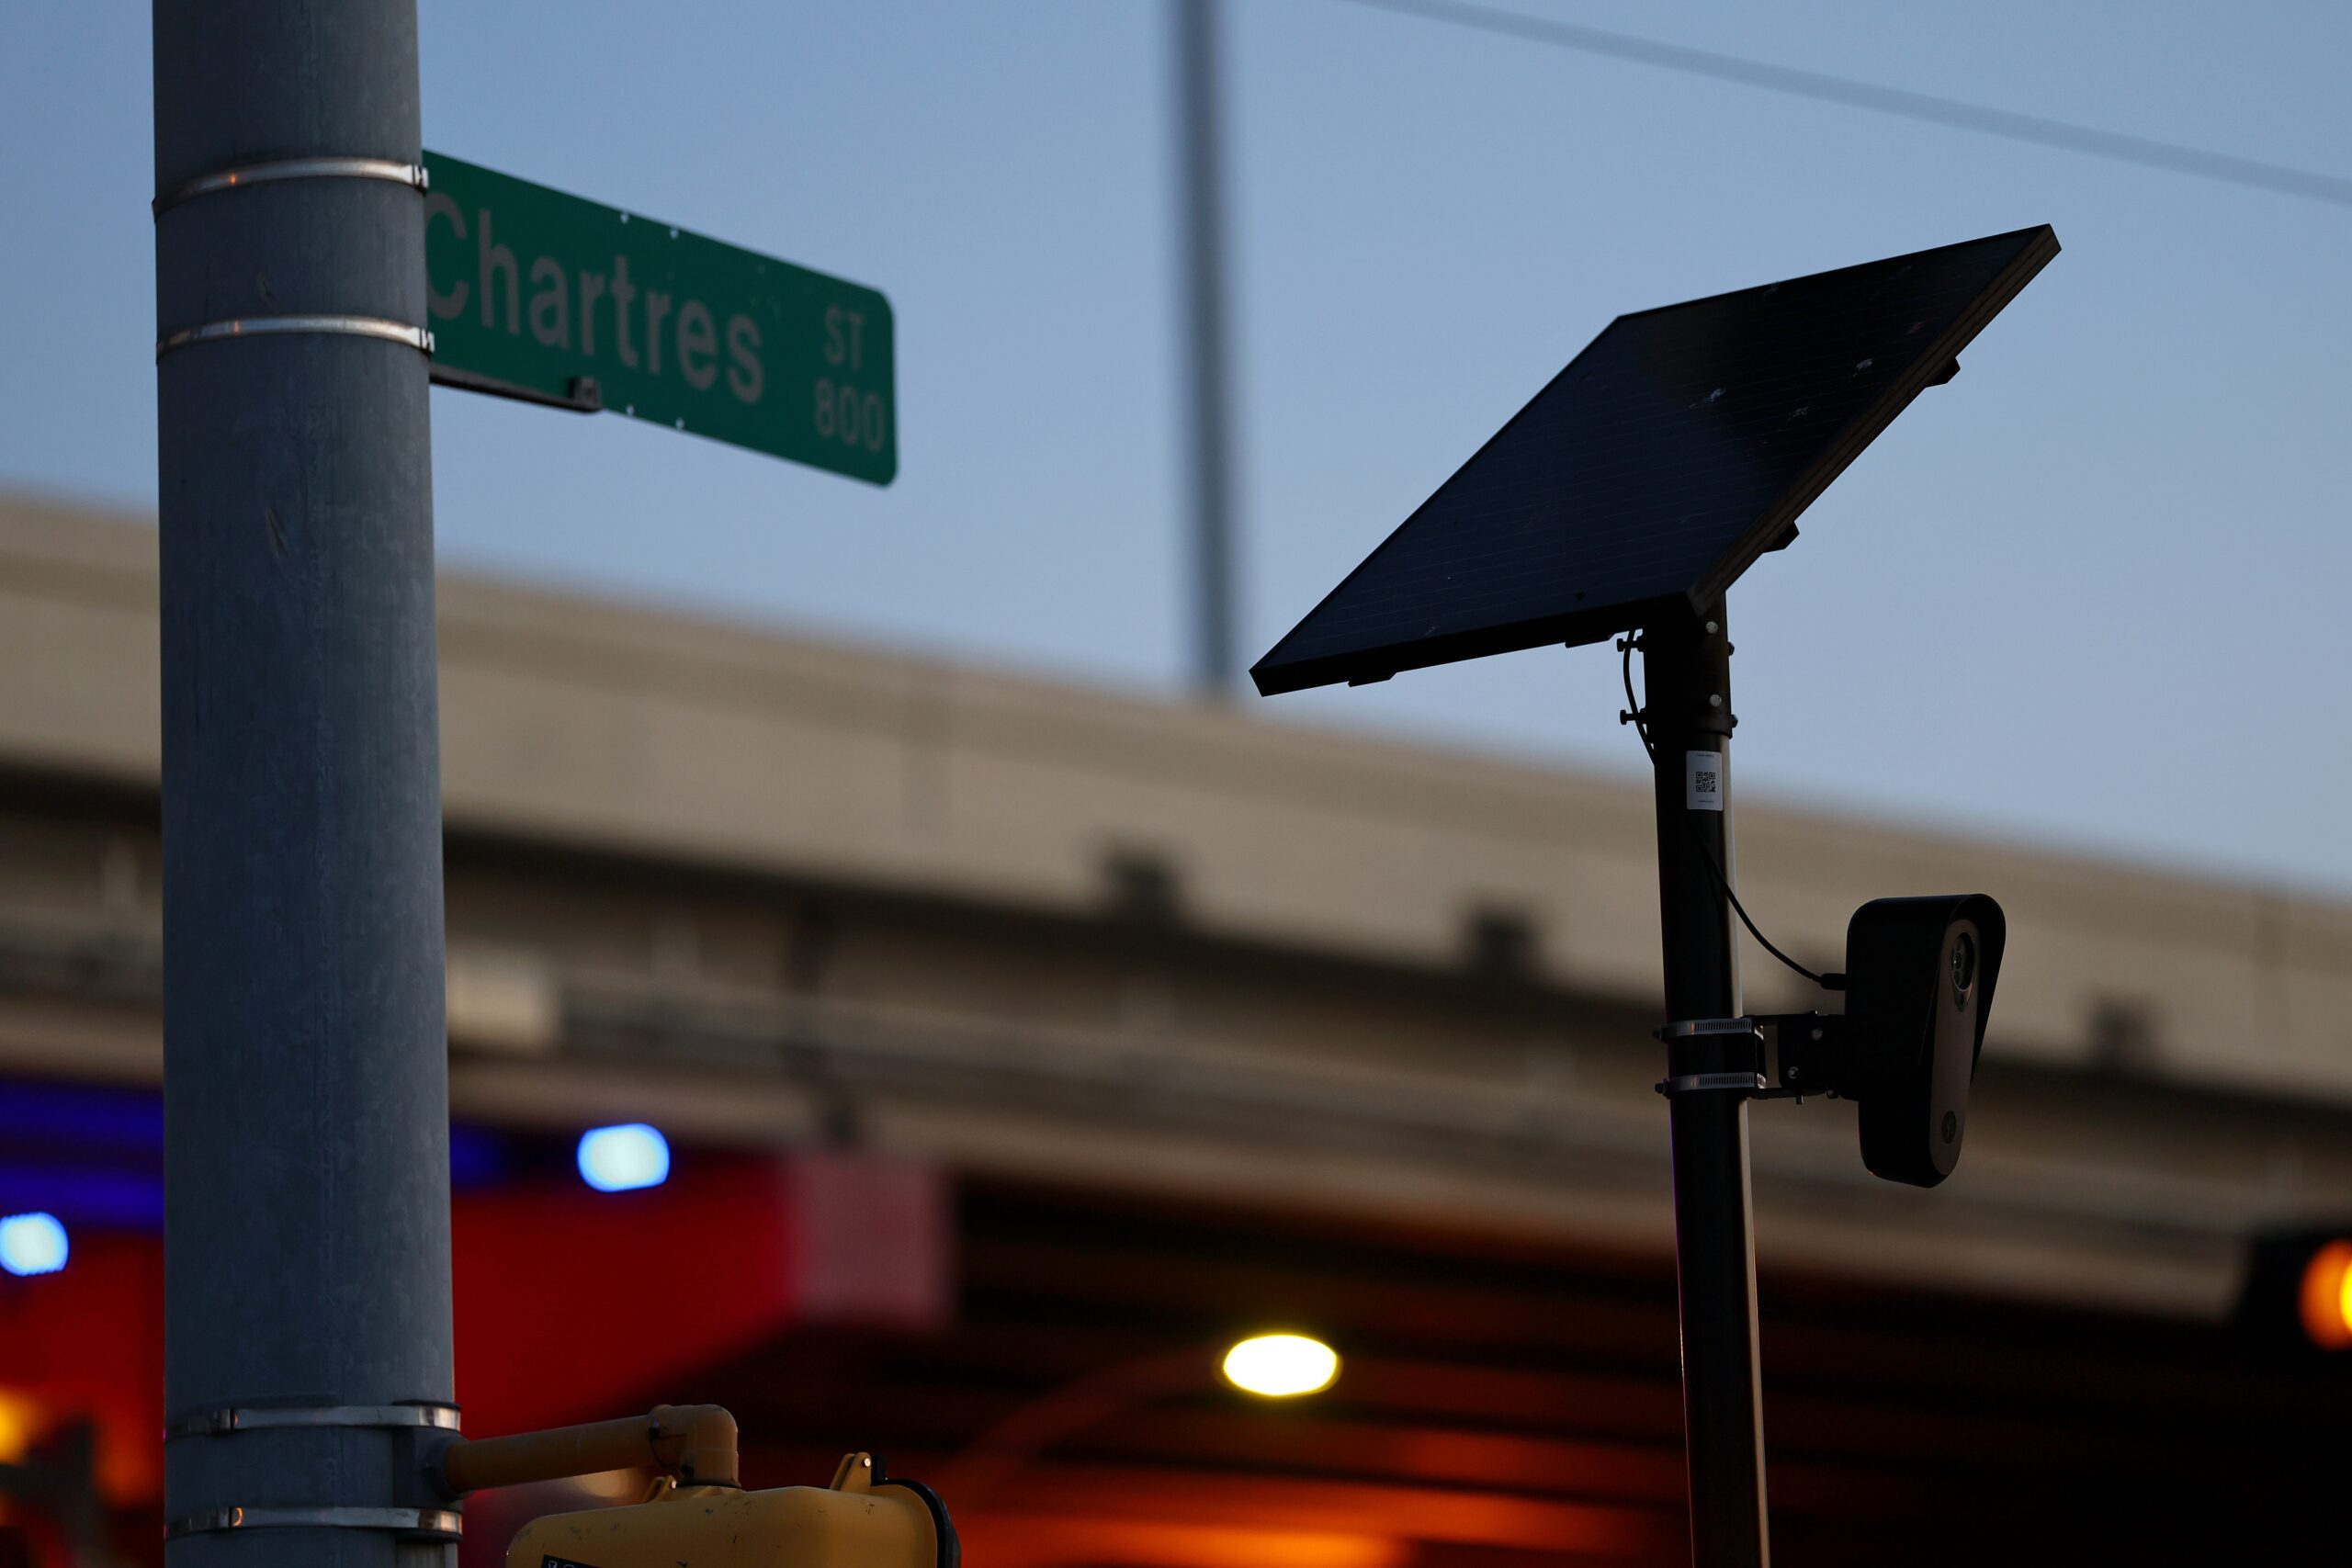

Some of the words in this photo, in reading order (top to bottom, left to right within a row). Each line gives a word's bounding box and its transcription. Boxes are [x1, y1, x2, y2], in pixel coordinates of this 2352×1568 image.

[424, 191, 763, 404] Chartres
[823, 306, 864, 373] ST
[815, 378, 886, 452] 800
